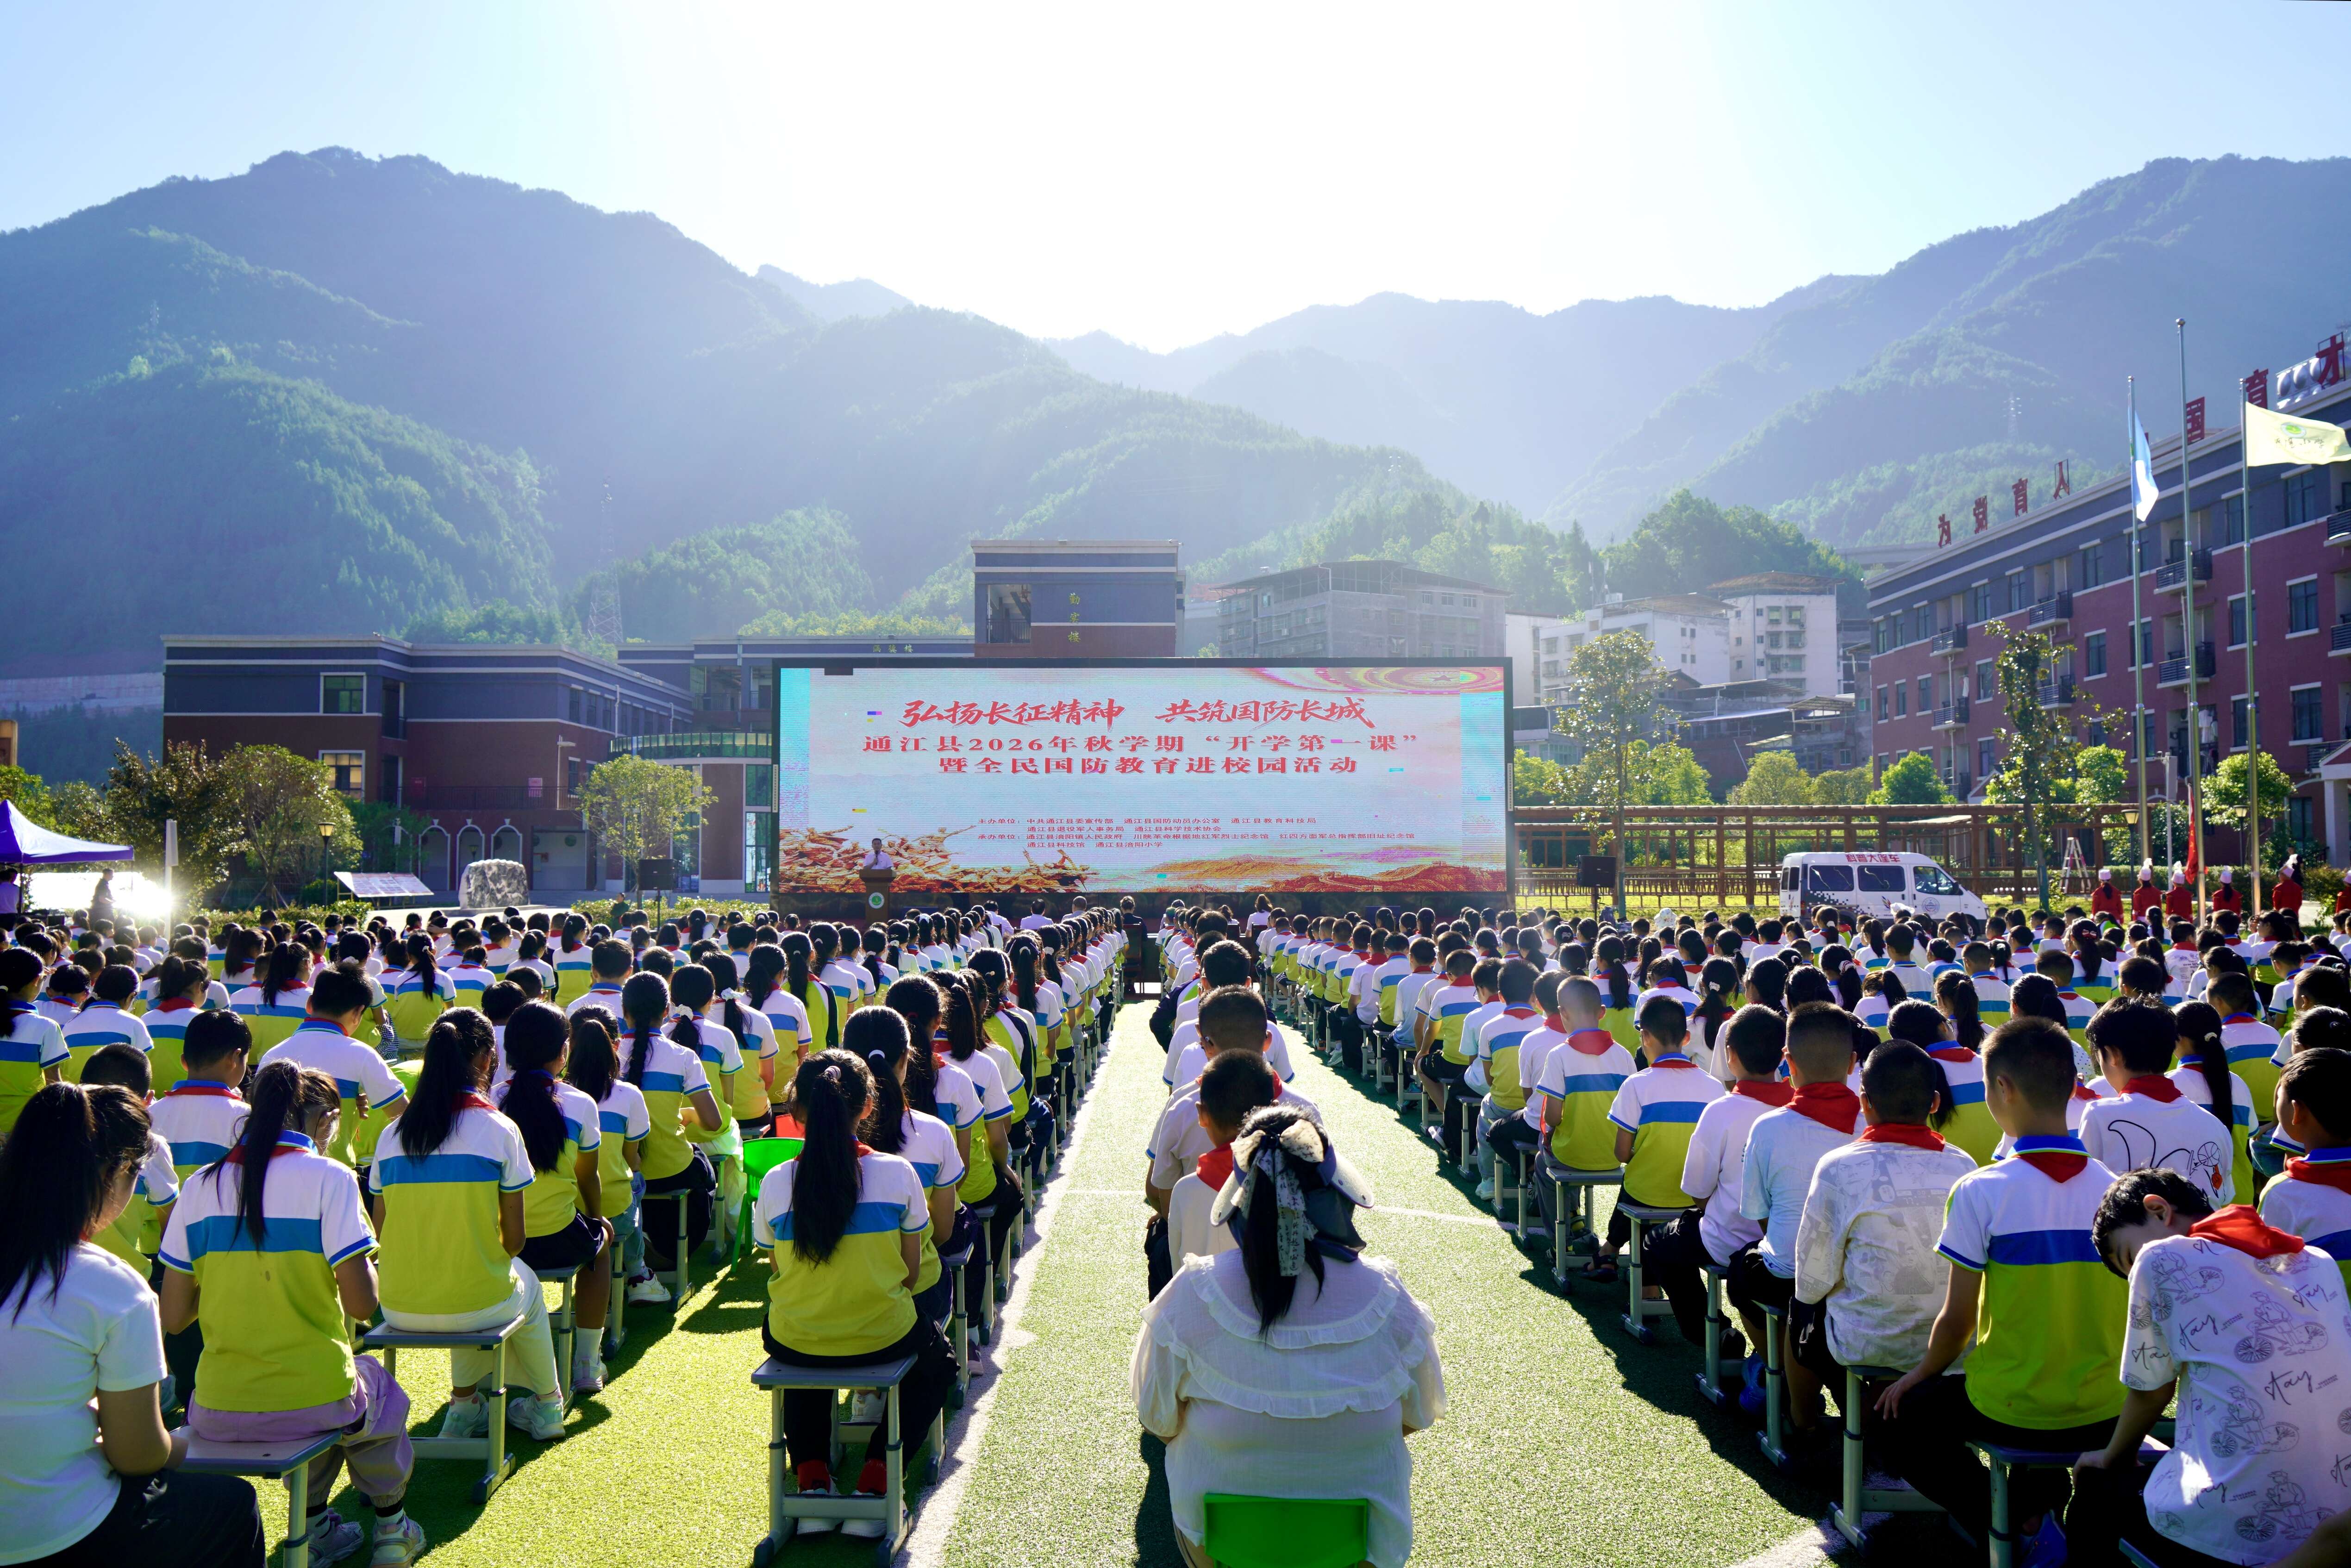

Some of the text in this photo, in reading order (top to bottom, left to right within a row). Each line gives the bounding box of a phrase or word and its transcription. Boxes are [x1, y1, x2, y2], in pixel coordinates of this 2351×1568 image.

[1938, 458, 2070, 549] 为党育人
[898, 697, 1376, 731] 弘扬长征精神 共筑国防长城
[938, 756, 1357, 774] 暨全民国防教育进校园活动
